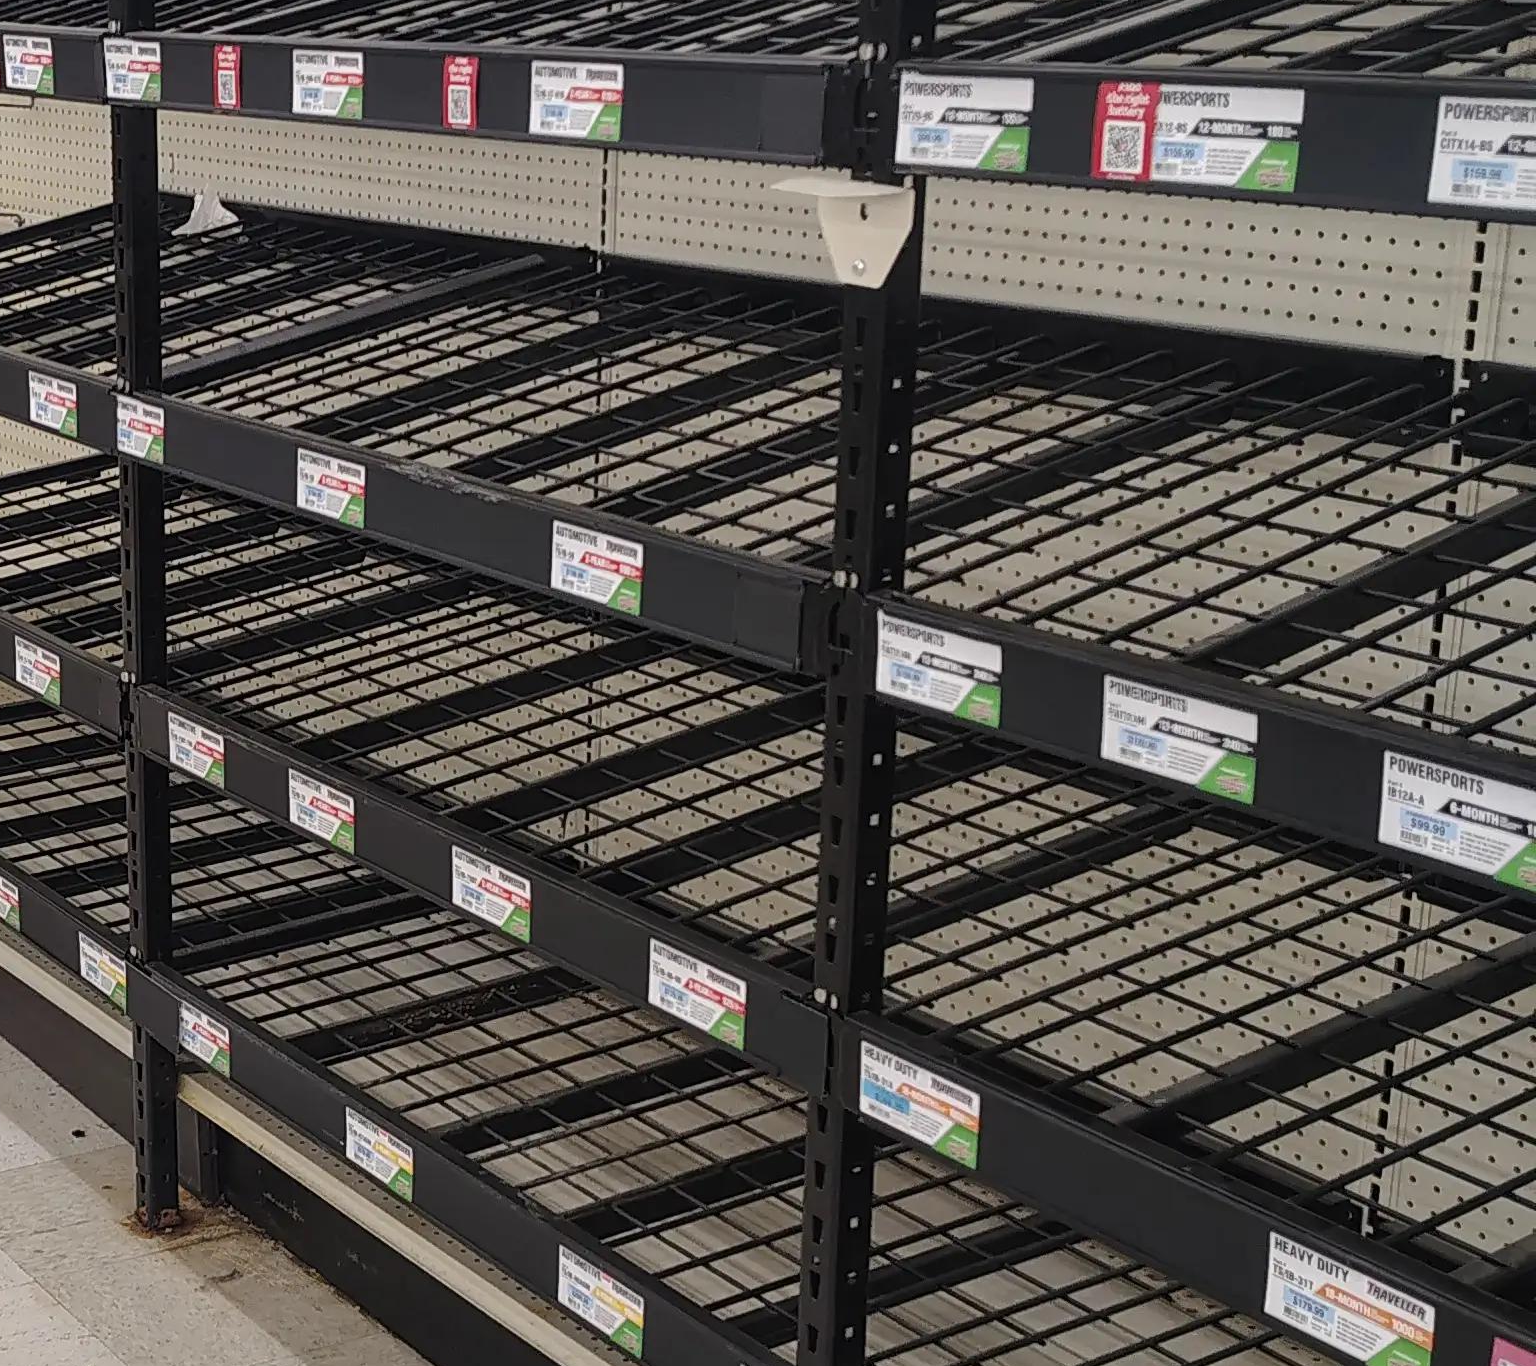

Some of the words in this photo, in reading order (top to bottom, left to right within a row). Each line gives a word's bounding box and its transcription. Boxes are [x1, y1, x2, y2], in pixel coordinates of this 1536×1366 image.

[903, 81, 974, 98] POWERSPORTS
[1444, 102, 1536, 123] POWERSPORT
[555, 524, 598, 547] AUTOMOTIVE
[883, 619, 946, 648] POWERSPORTS
[1108, 678, 1188, 713] POWERSPORTS
[1389, 755, 1485, 796] POWERSPORTS
[1449, 800, 1500, 827] 6-MONTH
[653, 943, 699, 973] AUTOMOTIVE
[864, 1045, 894, 1068] HEAVY
[894, 1059, 920, 1080] DUTY
[1273, 1236, 1315, 1266] HEAVY
[1317, 1257, 1350, 1282] DUTY
[1366, 1280, 1428, 1322] TRAVELLER
[1391, 1318, 1415, 1339] 1000
